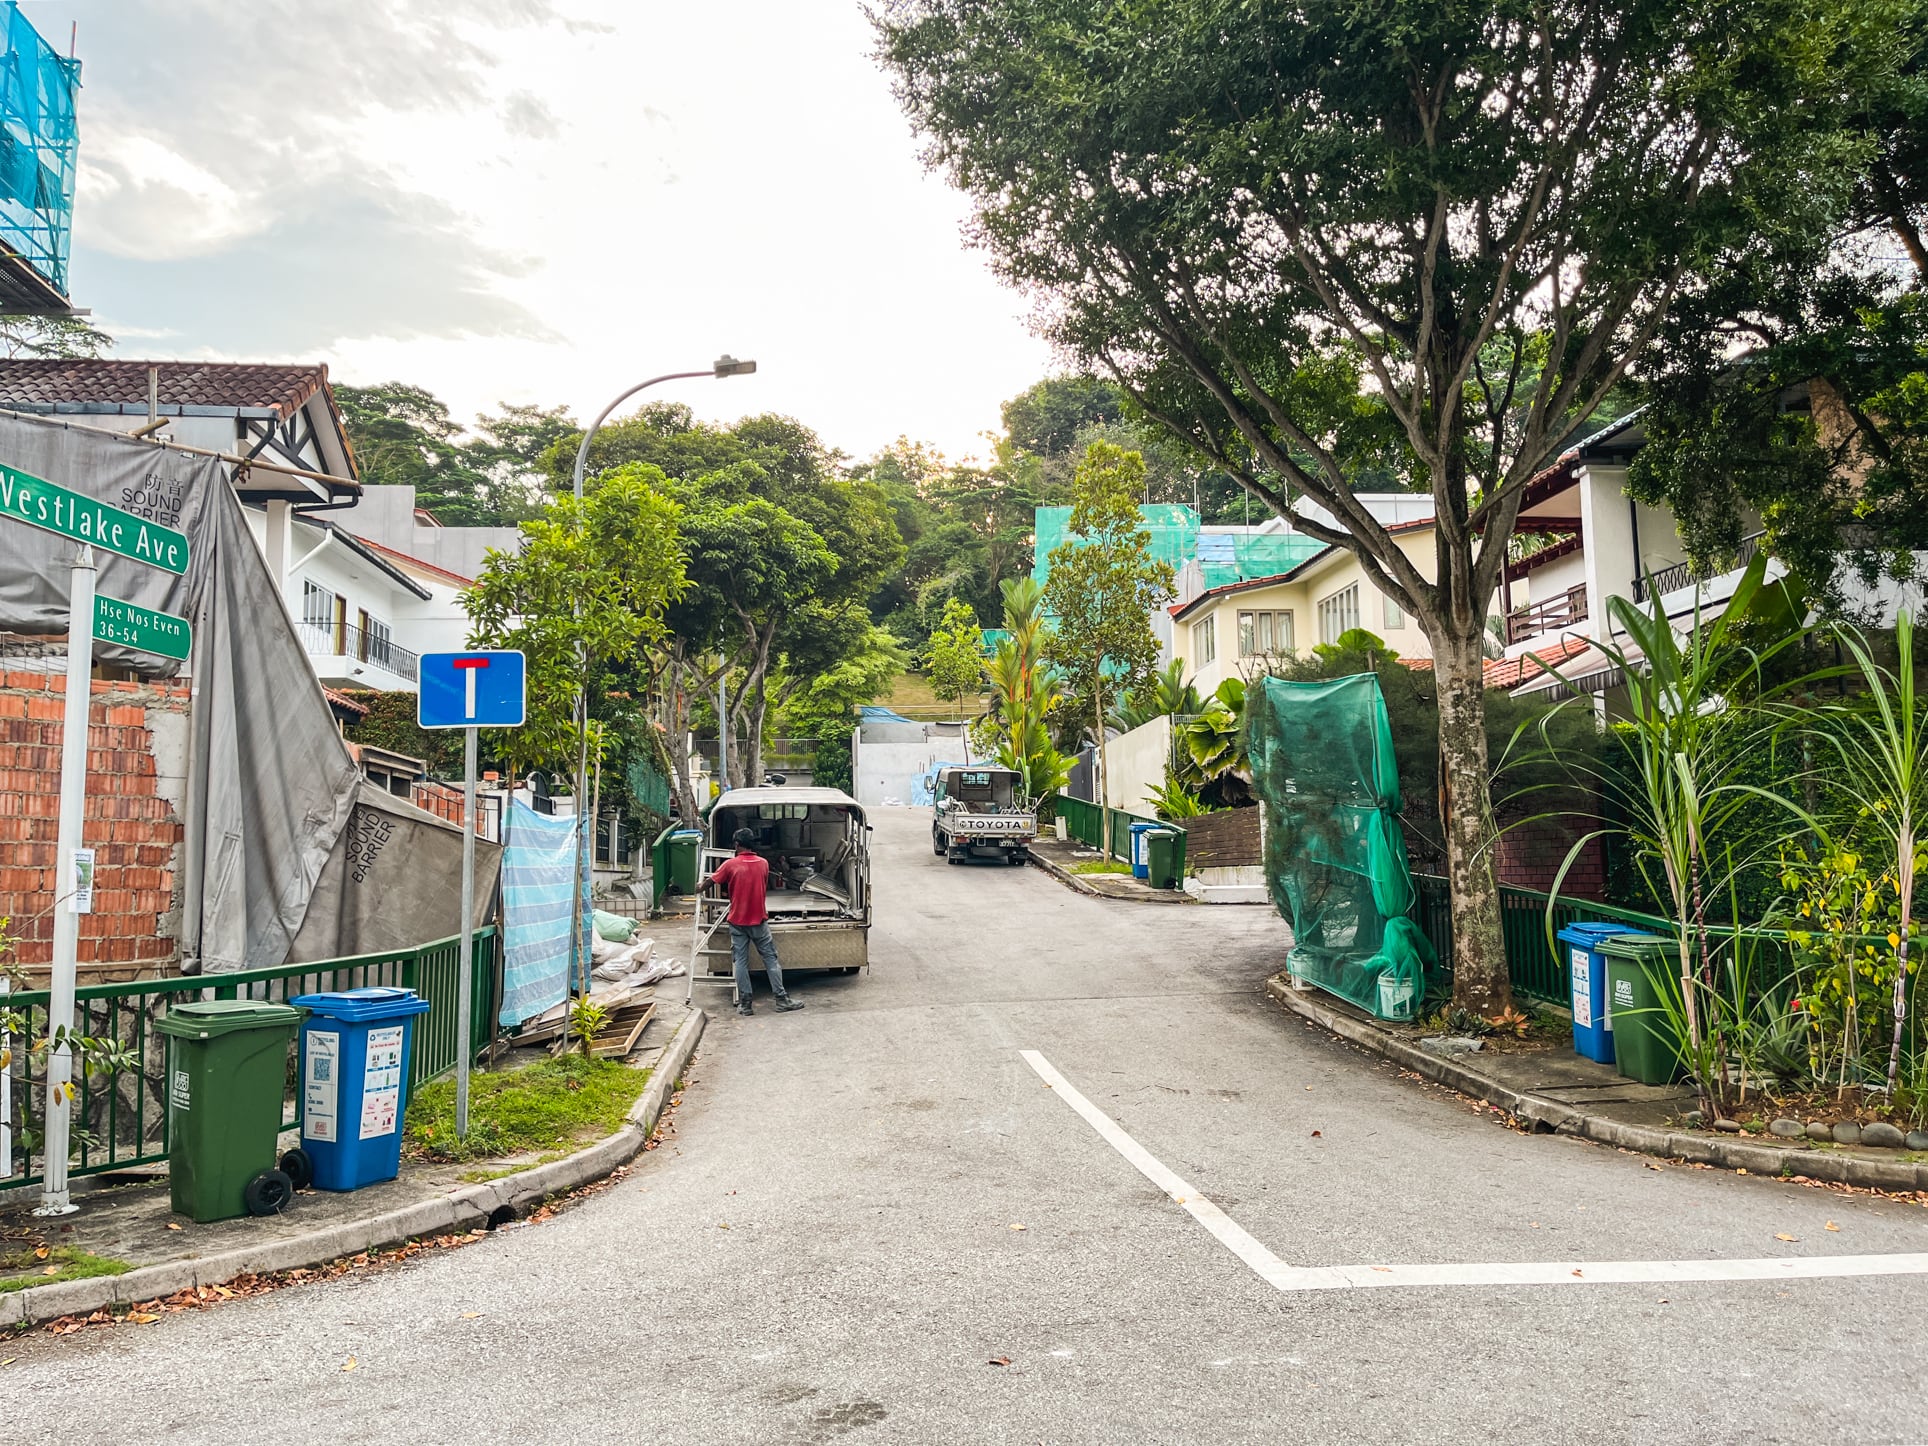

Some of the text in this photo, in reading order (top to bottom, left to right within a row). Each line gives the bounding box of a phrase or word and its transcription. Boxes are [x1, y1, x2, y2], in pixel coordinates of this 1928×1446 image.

[122, 488, 182, 513] SOUND
[136, 525, 178, 567] Ave
[99, 621, 138, 644] 36-54
[100, 600, 180, 636] Hse Nos Even
[345, 813, 380, 863] SOUND
[968, 820, 1021, 829] TOYOTA
[351, 821, 396, 883] BARRIER
